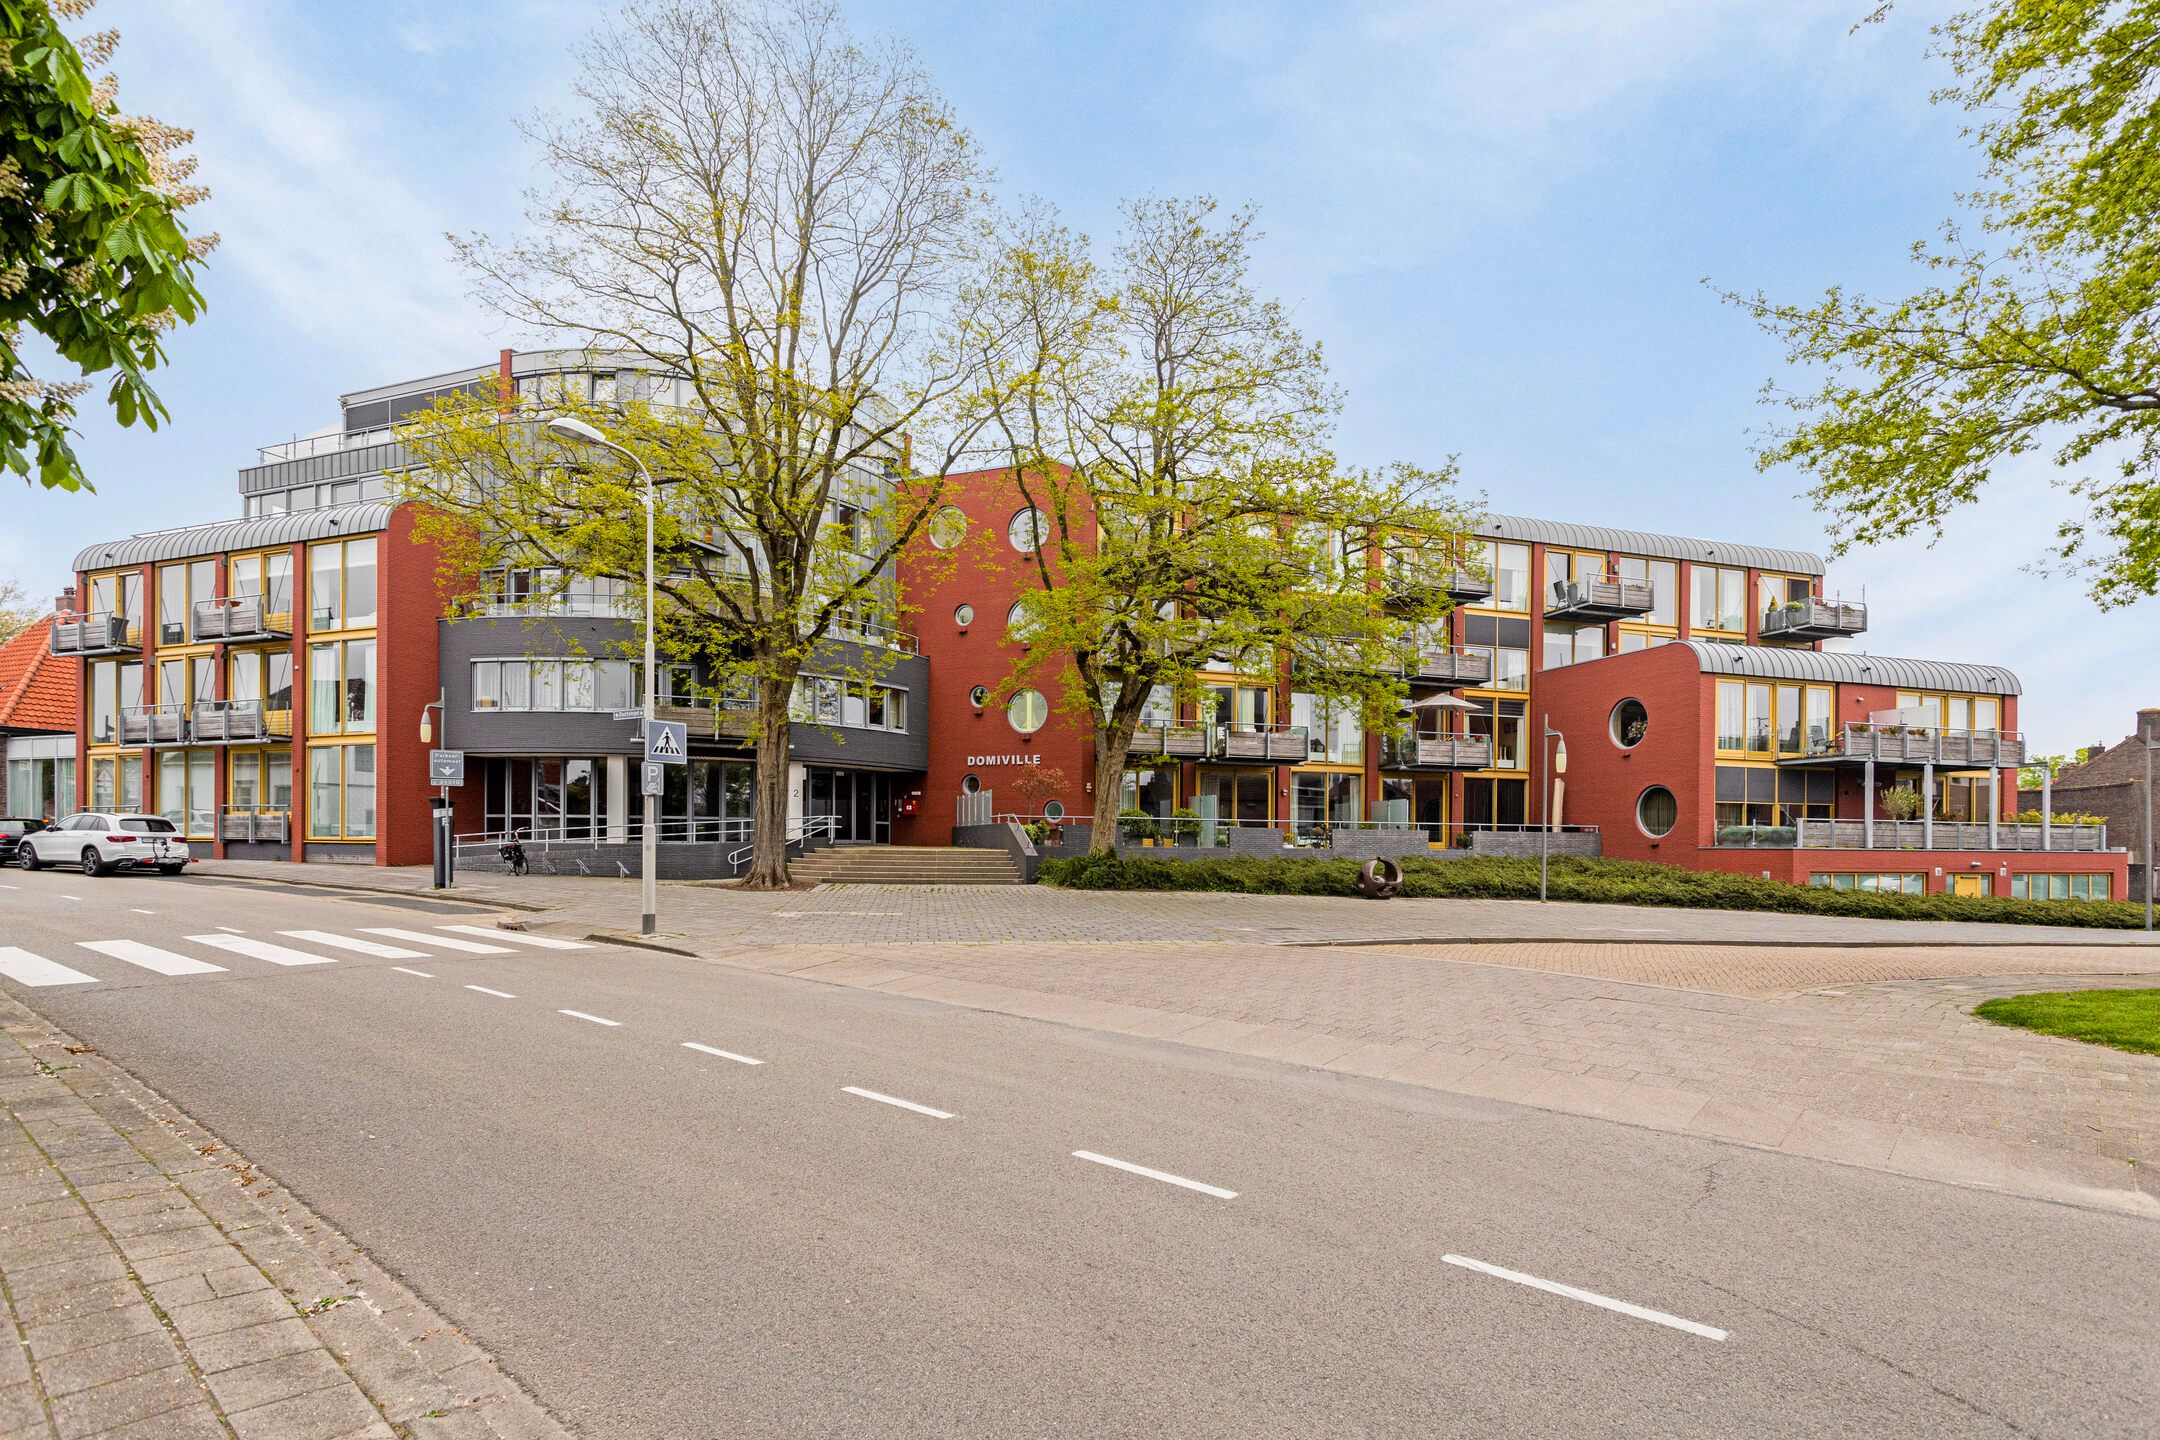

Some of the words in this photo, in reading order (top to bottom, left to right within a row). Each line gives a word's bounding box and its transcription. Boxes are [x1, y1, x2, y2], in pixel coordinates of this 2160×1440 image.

[967, 754, 1041, 766] DOMIVILLE
[647, 766, 659, 781] P
[793, 789, 799, 798] 2
